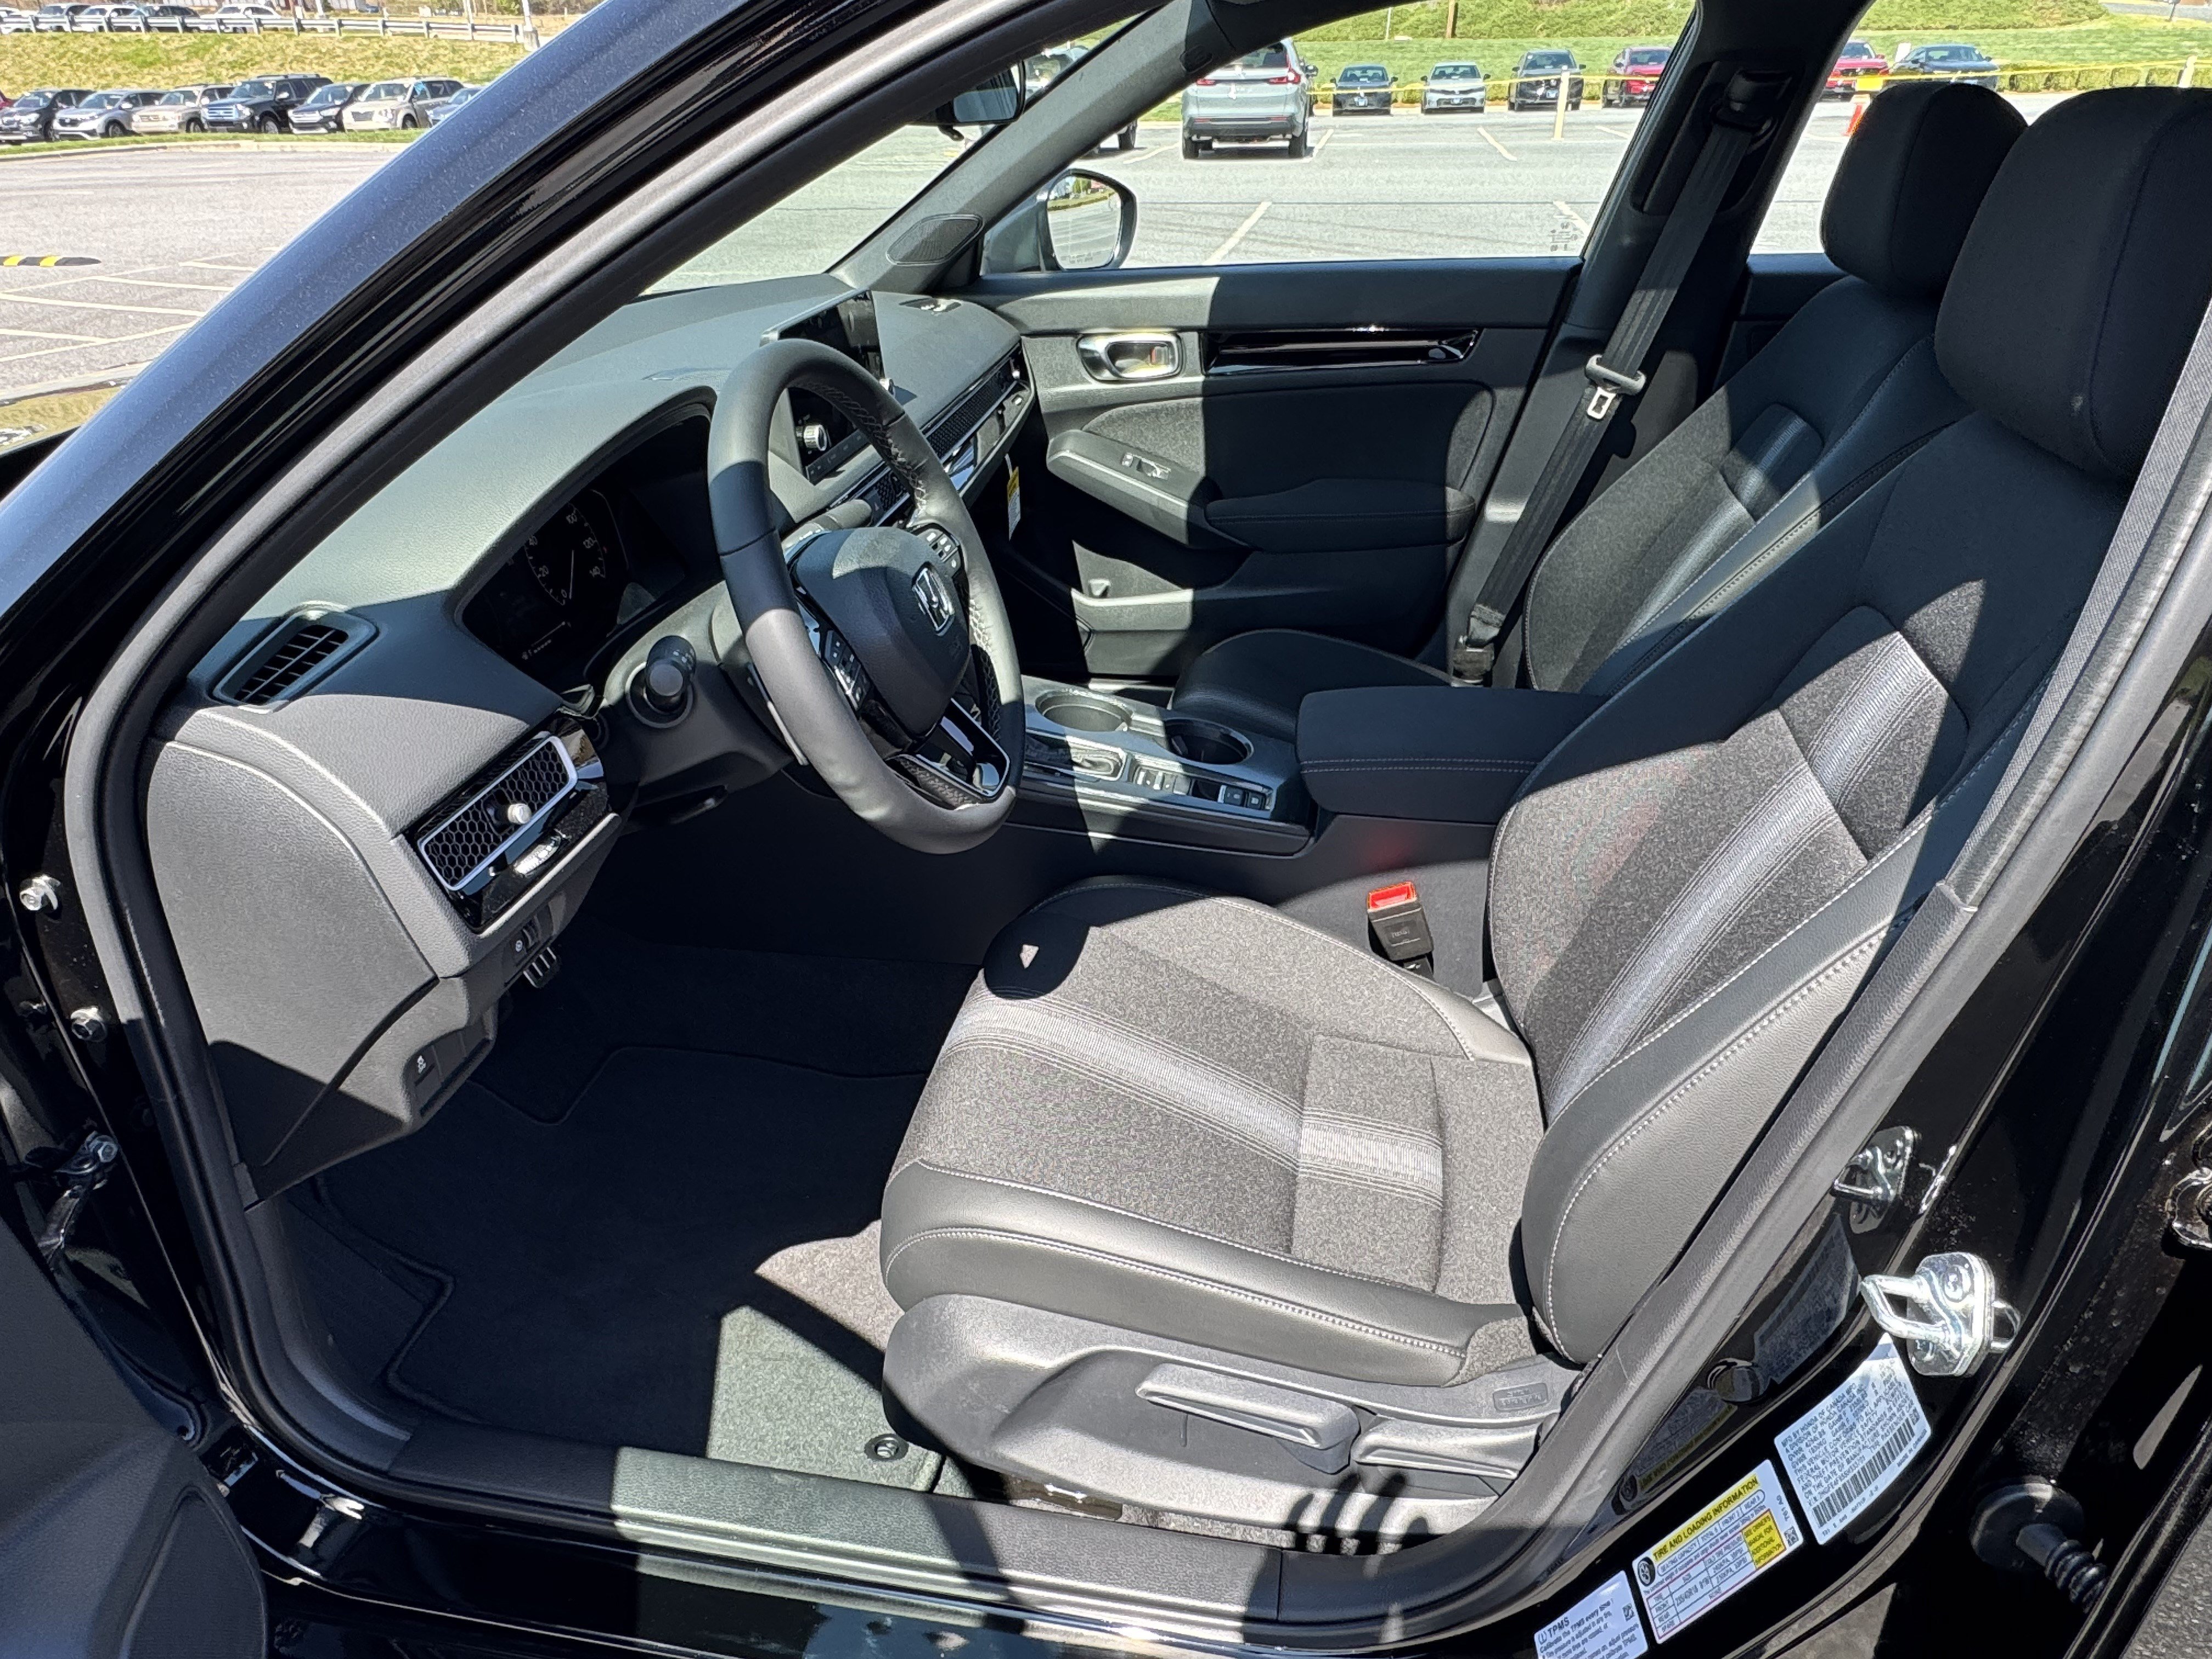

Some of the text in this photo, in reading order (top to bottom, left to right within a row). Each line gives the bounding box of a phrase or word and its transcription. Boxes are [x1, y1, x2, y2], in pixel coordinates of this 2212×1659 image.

[539, 566, 549, 577] 20
[1788, 1429, 1812, 1451] DIVISION
[1819, 1409, 1837, 1427] HONDA
[1836, 1391, 1856, 1413] CANADA
[1799, 1414, 1818, 1432] HONDA
[1825, 1391, 1846, 1413] CANADA
[1880, 1409, 1905, 1441] PASSENGER
[1904, 1398, 1914, 1413] CAR
[1793, 1462, 1807, 1476] THIS
[1806, 1445, 1829, 1467] VEHICLE
[1828, 1421, 1857, 1449] CONFORMS
[1855, 1413, 1864, 1425] TO
[1864, 1405, 1874, 1418] ALL
[1797, 1463, 1820, 1485] FEDERAL
[1820, 1447, 1839, 1466] MOTOR
[1839, 1428, 1860, 1450] VEHICLE
[1801, 1478, 1812, 1492] AND
[1812, 1465, 1829, 1482] THEFT
[1829, 1438, 1860, 1468] PREVENTION
[1859, 1410, 1887, 1442] STANDARDS
[1803, 1488, 1813, 1499] ON
[1812, 1480, 1824, 1492] THE
[1823, 1468, 1837, 1483] DATE
[1837, 1462, 1844, 1472] OF
[1845, 1429, 1880, 1465] MANUFACTURE
[1880, 1410, 1897, 1432] SHOWN
[1653, 1476, 1758, 1561] TIRE AND LOADING INFORMATION
[1677, 1542, 1697, 1560] CAPACITY
[1721, 1512, 1736, 1526] FRONT
[1743, 1497, 1757, 1510] REAR
[1763, 1524, 1773, 1536] FOR
[1547, 1615, 1570, 1638] TPMS
[1570, 1617, 1585, 1633] TPMS
